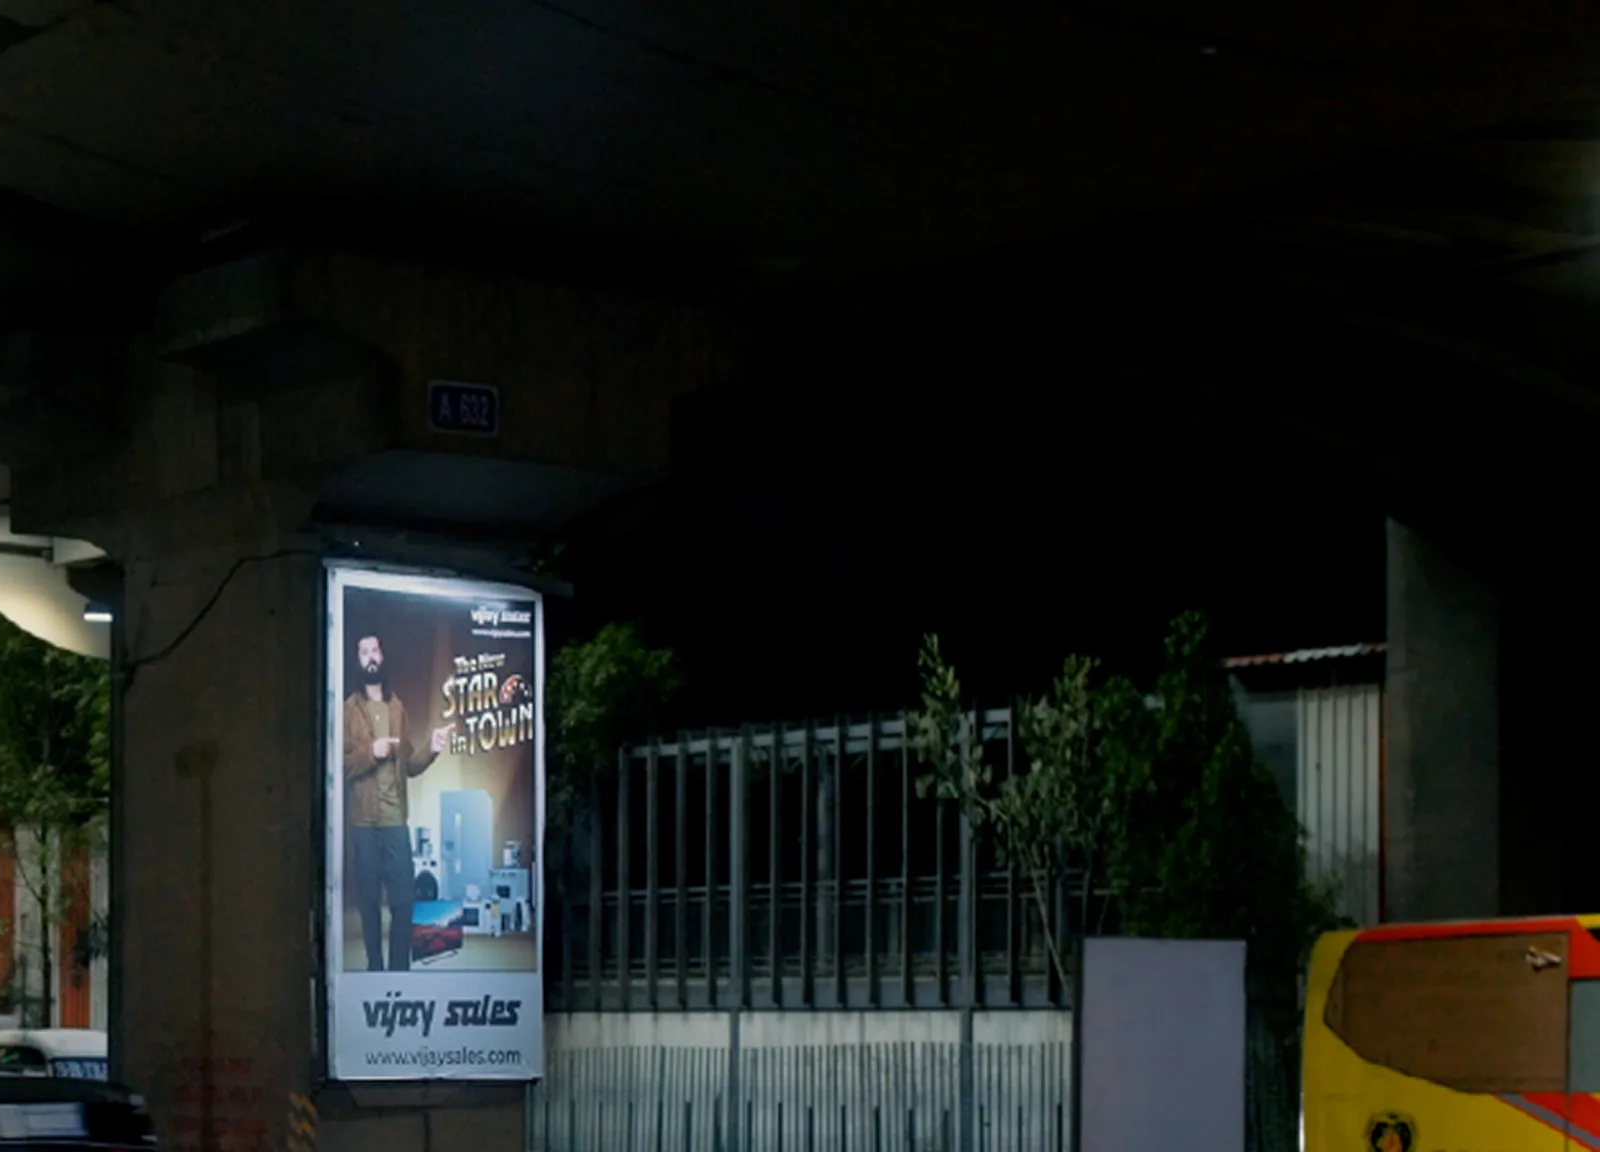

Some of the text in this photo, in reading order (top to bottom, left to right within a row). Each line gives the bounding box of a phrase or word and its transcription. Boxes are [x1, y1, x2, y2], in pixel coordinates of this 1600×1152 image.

[439, 390, 453, 423] A
[454, 656, 477, 674] The
[442, 672, 498, 718] STAR
[451, 703, 533, 754] in TOWN
[363, 991, 521, 1038] vijay sales
[365, 1046, 522, 1068] www.vijaysales.com
